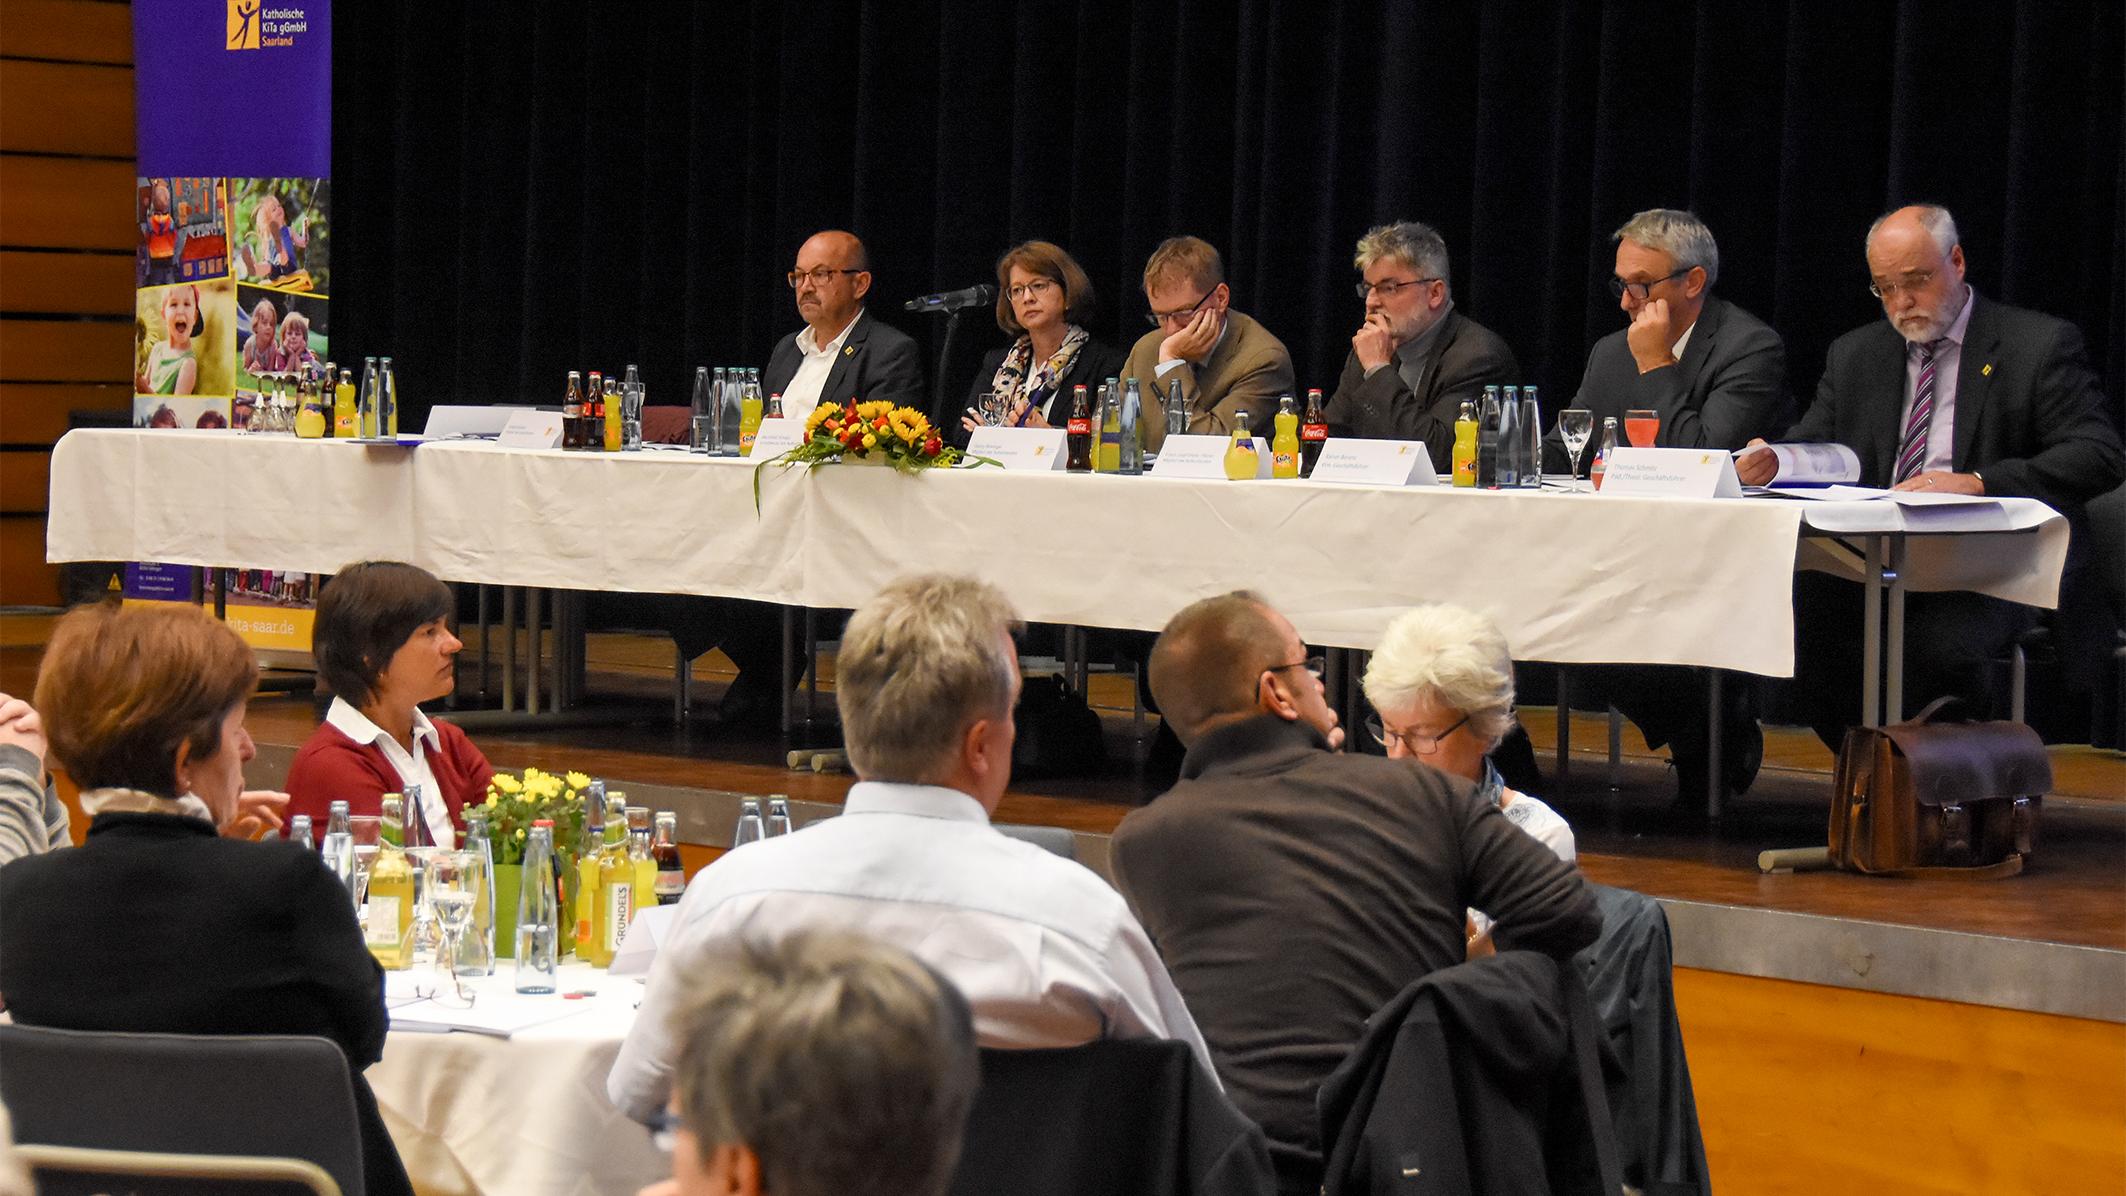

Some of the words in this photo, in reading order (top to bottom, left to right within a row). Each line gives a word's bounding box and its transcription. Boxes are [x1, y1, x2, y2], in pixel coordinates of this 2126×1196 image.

[262, 8, 304, 19] Katholische
[262, 22, 278, 33] KiTa
[279, 22, 307, 35] gGmbH
[262, 36, 293, 47] Saarland
